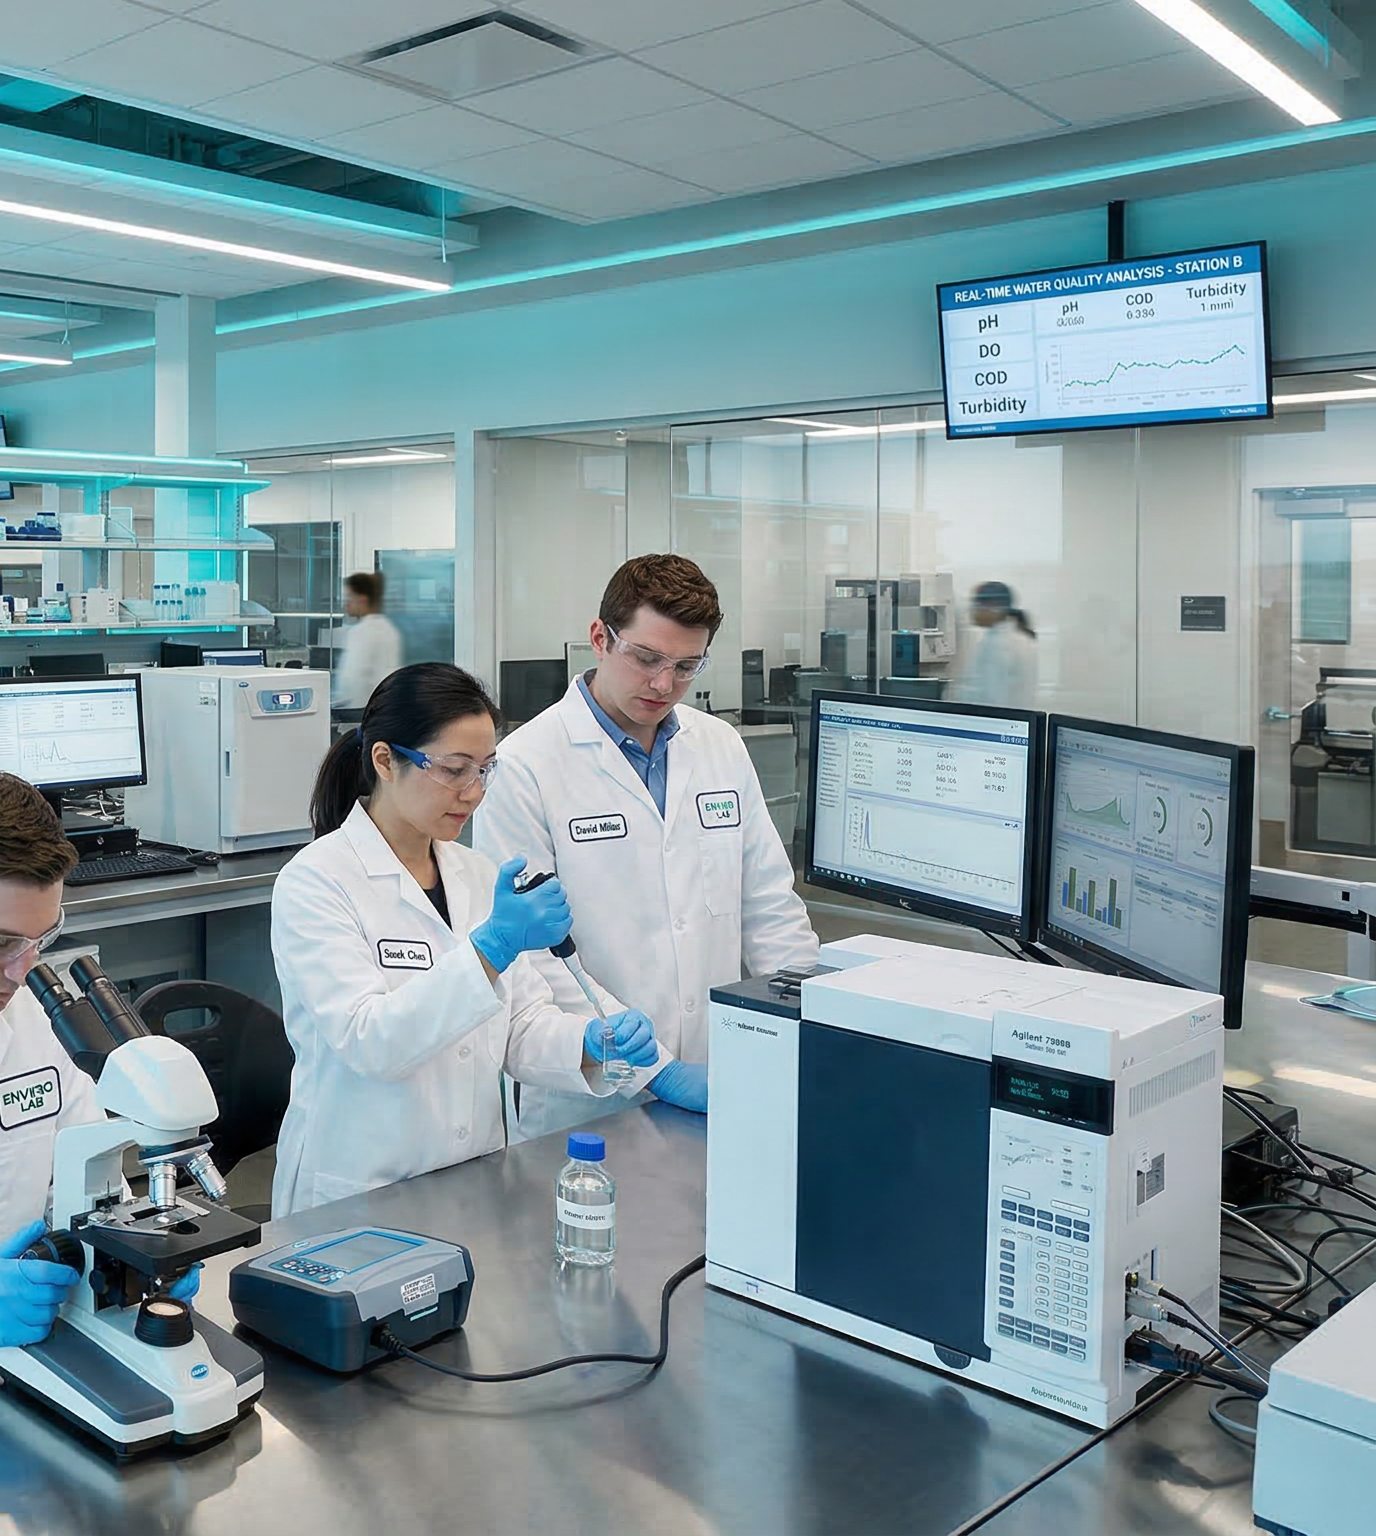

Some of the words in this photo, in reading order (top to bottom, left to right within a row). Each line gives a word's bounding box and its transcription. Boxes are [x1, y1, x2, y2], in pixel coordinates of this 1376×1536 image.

[954, 285, 1012, 303] REAL-TIME
[1013, 281, 1051, 296] WATER
[1054, 273, 1103, 290] QUALITY
[1106, 265, 1164, 284] ANALYSIS
[1175, 257, 1229, 275] STATION
[1233, 255, 1243, 268] B
[1186, 282, 1246, 299] Turbidity
[1126, 292, 1153, 306] COD
[1062, 301, 1078, 316] pH
[978, 314, 998, 333] pH
[979, 343, 1000, 358] DO
[974, 371, 1007, 386] COD
[959, 396, 1026, 415] Turbidity
[575, 824, 598, 835] David
[1011, 1029, 1042, 1043] Agilent
[20, 1096, 44, 1112] LAB
